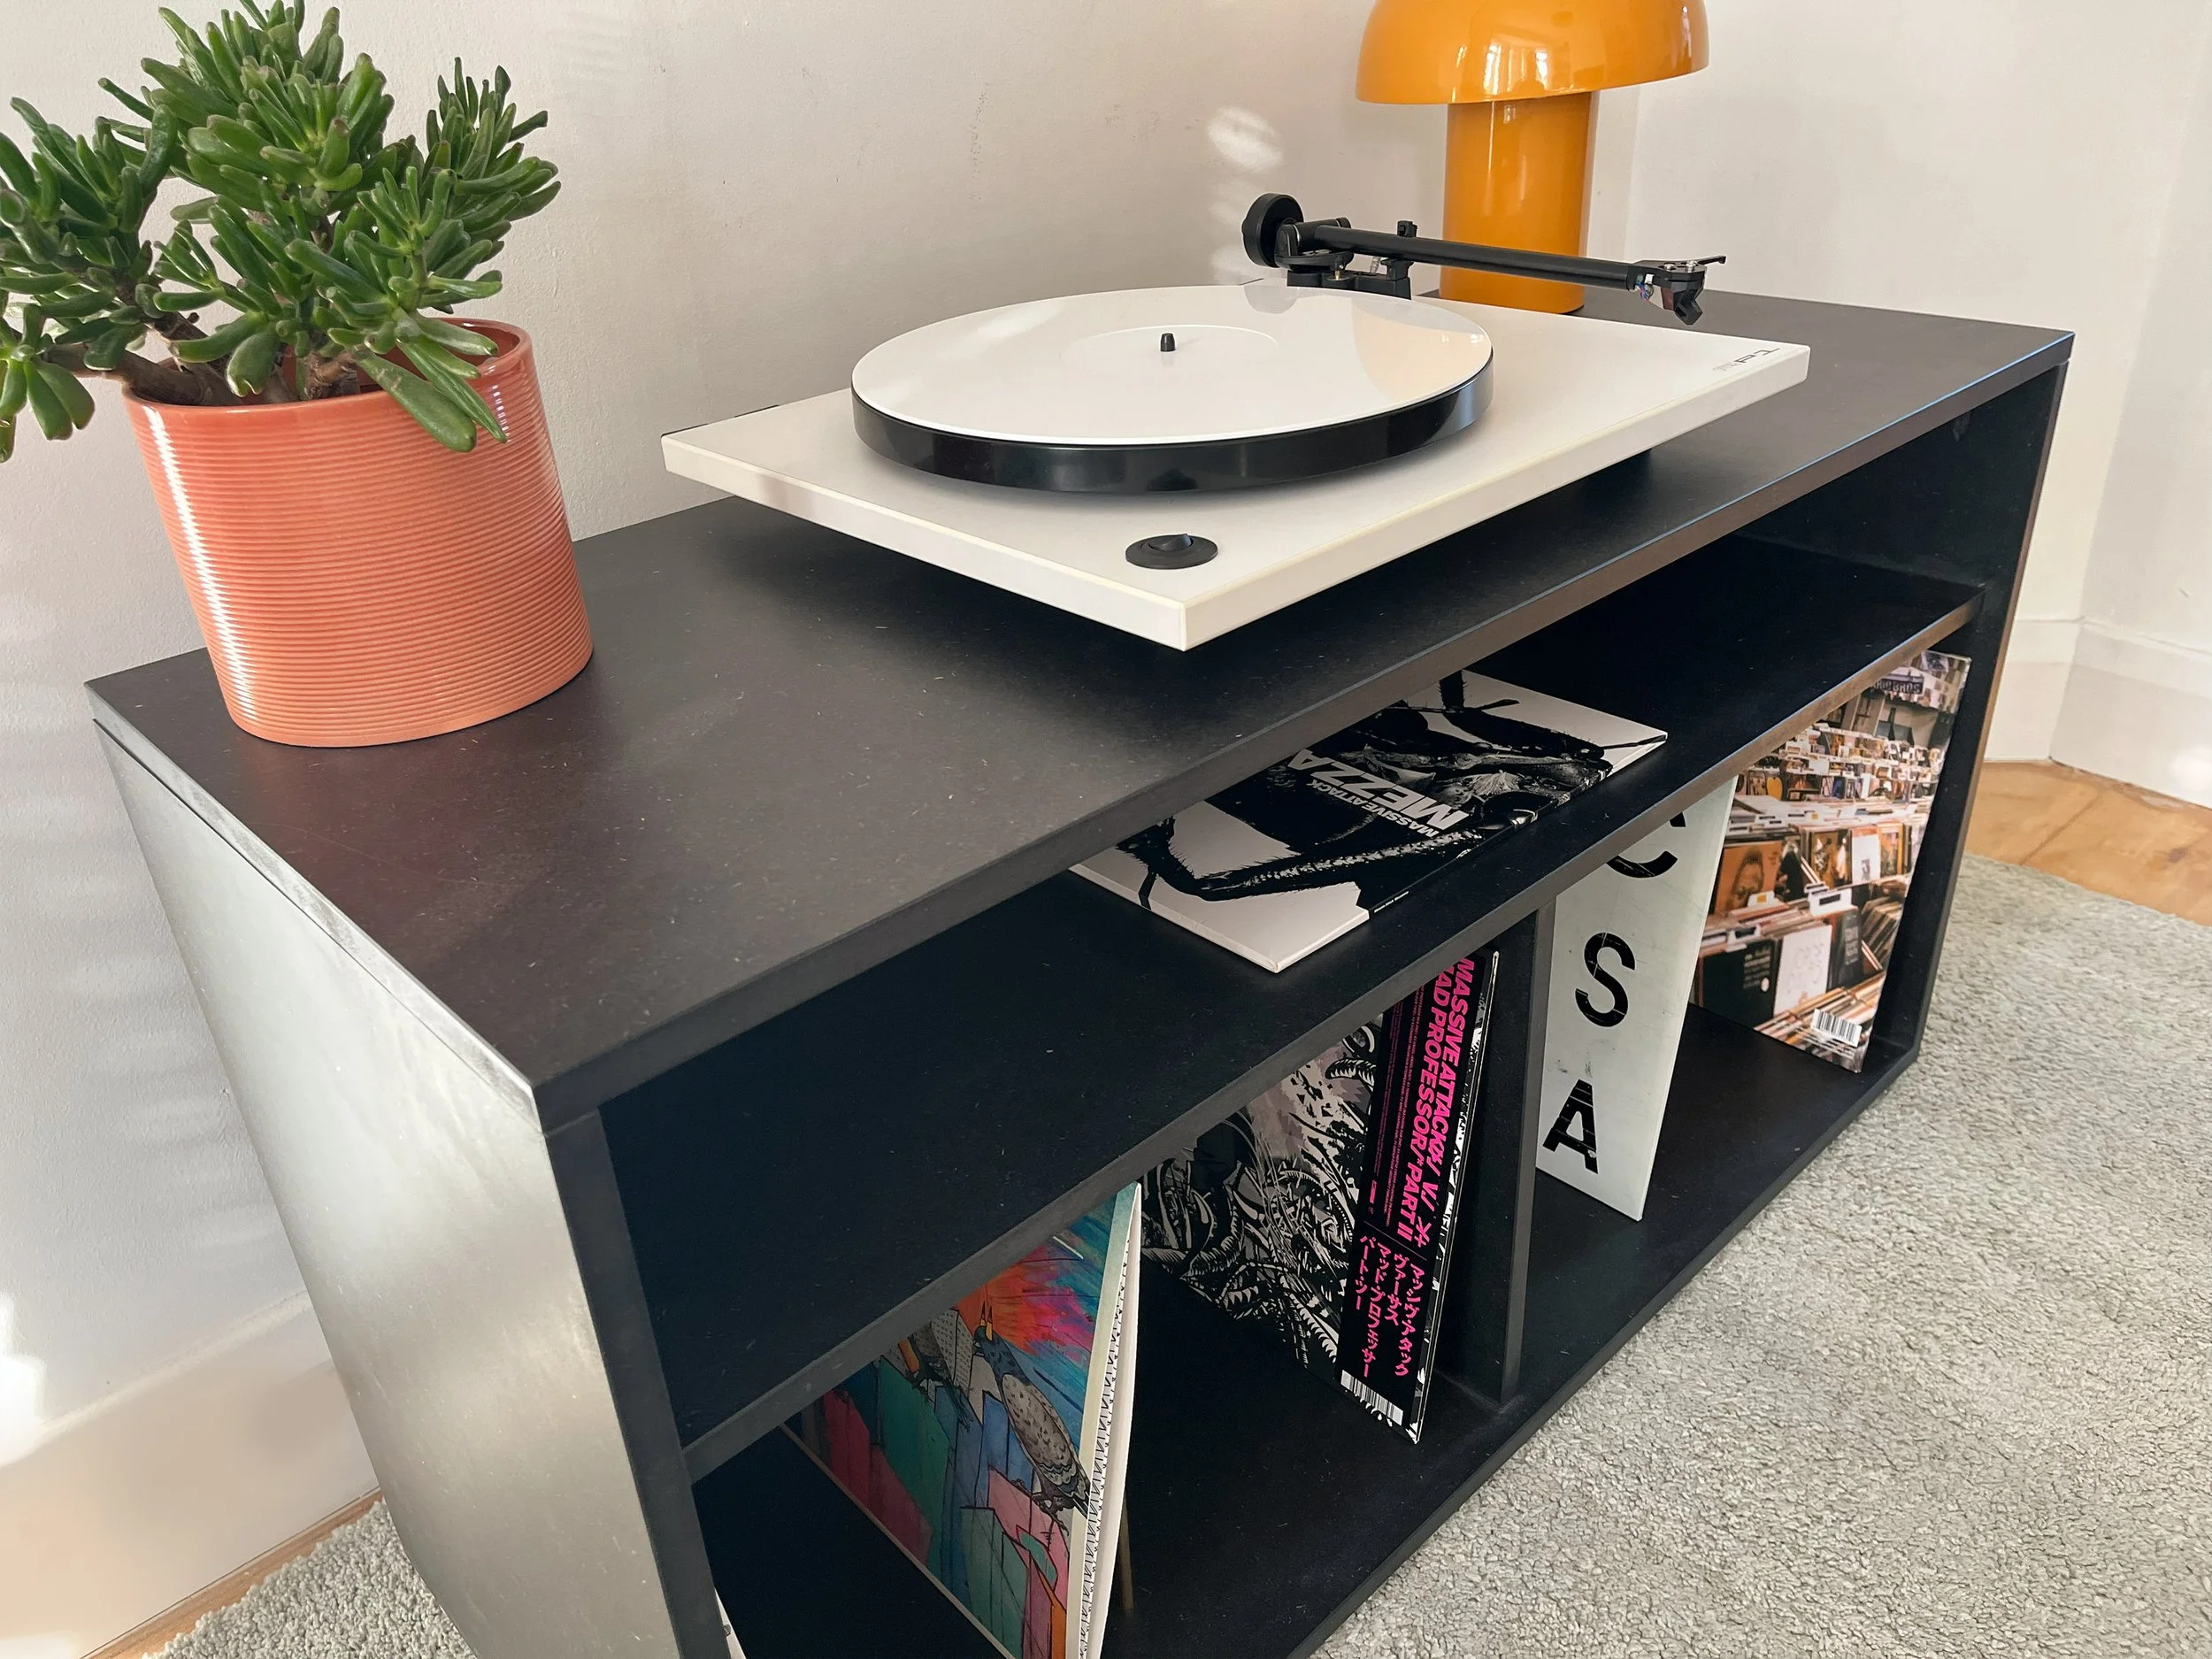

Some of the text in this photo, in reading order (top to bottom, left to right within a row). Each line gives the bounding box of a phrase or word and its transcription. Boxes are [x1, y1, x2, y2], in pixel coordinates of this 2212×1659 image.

[1306, 778, 1440, 838] MASSIVE ATTACK
[1432, 964, 1455, 1007] AD
[1442, 957, 1476, 1067] MASSIVE
[1399, 1162, 1422, 1225] PART
